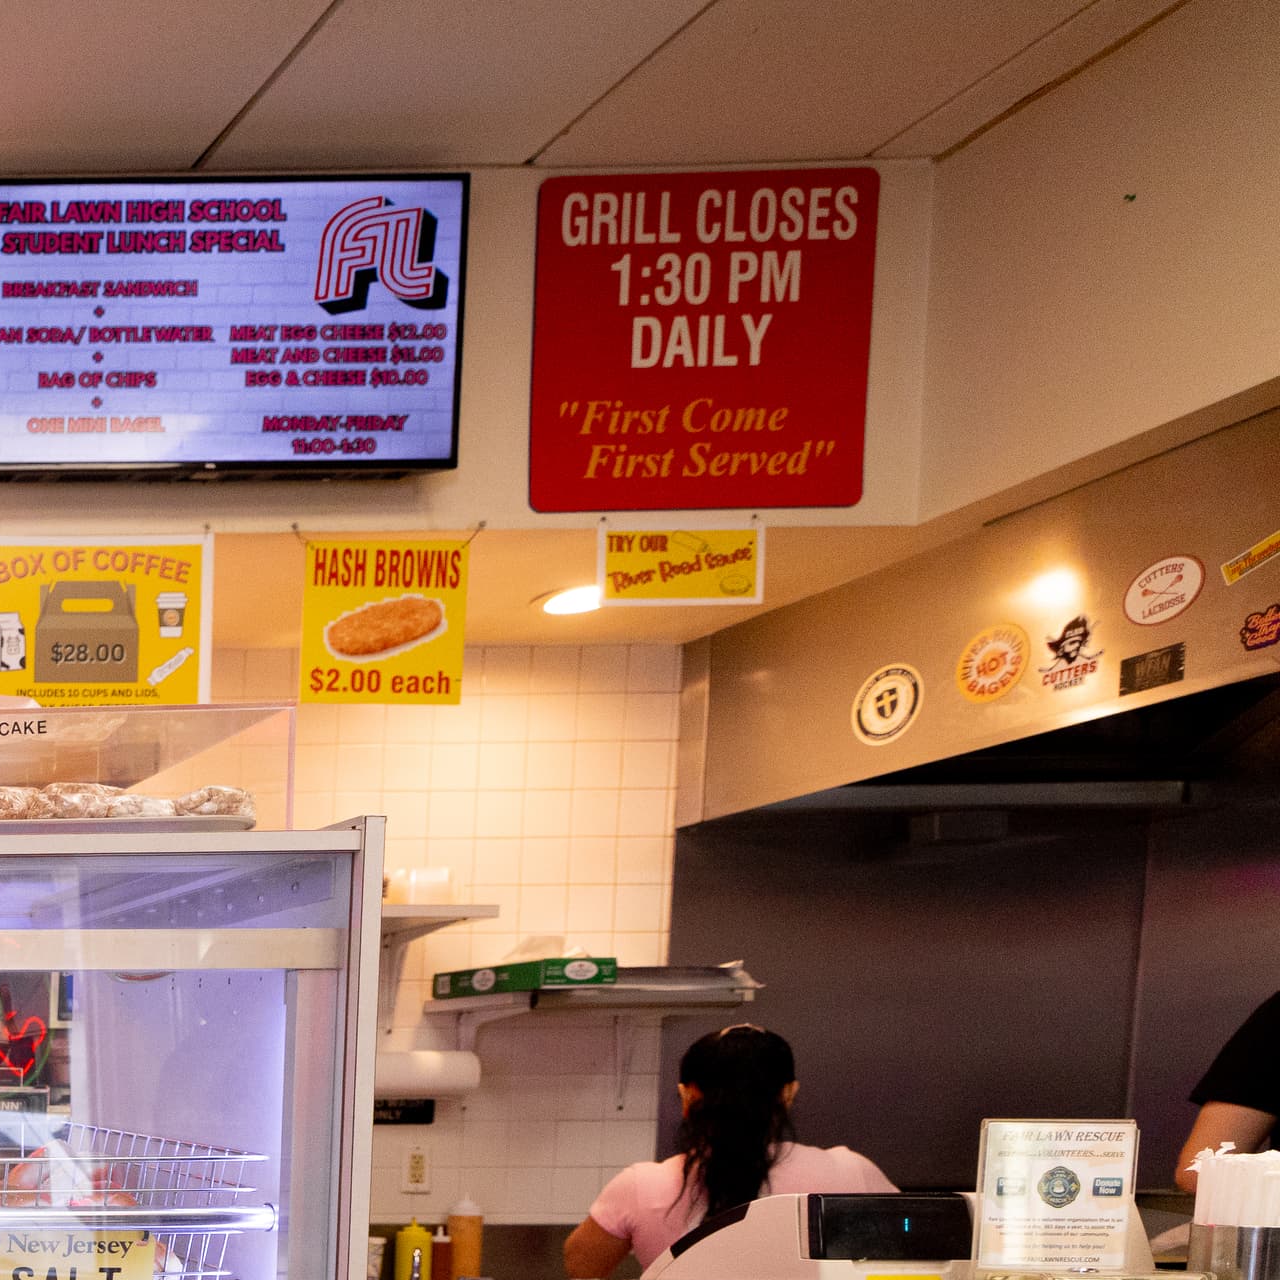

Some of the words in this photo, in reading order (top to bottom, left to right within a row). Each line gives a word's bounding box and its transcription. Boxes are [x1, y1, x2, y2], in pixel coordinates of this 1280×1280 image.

[51, 201, 123, 223] LAWN
[127, 201, 186, 223] HIGH
[190, 199, 287, 222] SCHOOL
[561, 191, 682, 247] GRILL
[696, 186, 859, 243] CLOSES
[2, 232, 103, 254] STUDENT
[107, 231, 186, 253] LUNCH
[190, 230, 285, 252] SPECIAL
[2, 281, 101, 298] BREAKFAST
[103, 280, 198, 296] SANDWICH
[610, 252, 712, 306] 1:30
[728, 250, 802, 304] PM
[281, 325, 317, 340] EGG
[320, 324, 385, 341] CHEESE
[631, 314, 774, 369] DAILY
[38, 372, 75, 388] BAG
[78, 372, 104, 387] OF
[105, 372, 157, 388] CHIPS
[558, 401, 671, 435] "First
[681, 398, 789, 433] Come
[583, 444, 675, 479] First
[681, 440, 836, 478] Served"
[607, 534, 637, 552] TRY
[640, 534, 669, 552] OUR
[52, 549, 86, 572] OF
[93, 549, 192, 584] COFFEE
[313, 547, 368, 588] HASH
[372, 547, 462, 590] BROWNS
[658, 554, 702, 583] Road
[1138, 563, 1185, 589] CUTTERS
[1141, 593, 1186, 619] LACROSSE
[51, 643, 125, 664] $28.00
[309, 668, 381, 695] $2.00
[391, 671, 452, 694] each
[1041, 660, 1097, 687] CUTTERS
[16, 688, 65, 698] INCLUDES
[68, 688, 79, 697] 10
[81, 687, 109, 698] CUPS
[111, 687, 133, 698] AND
[1076, 1131, 1126, 1143] RESCUE
[1099, 1186, 1116, 1195] Now
